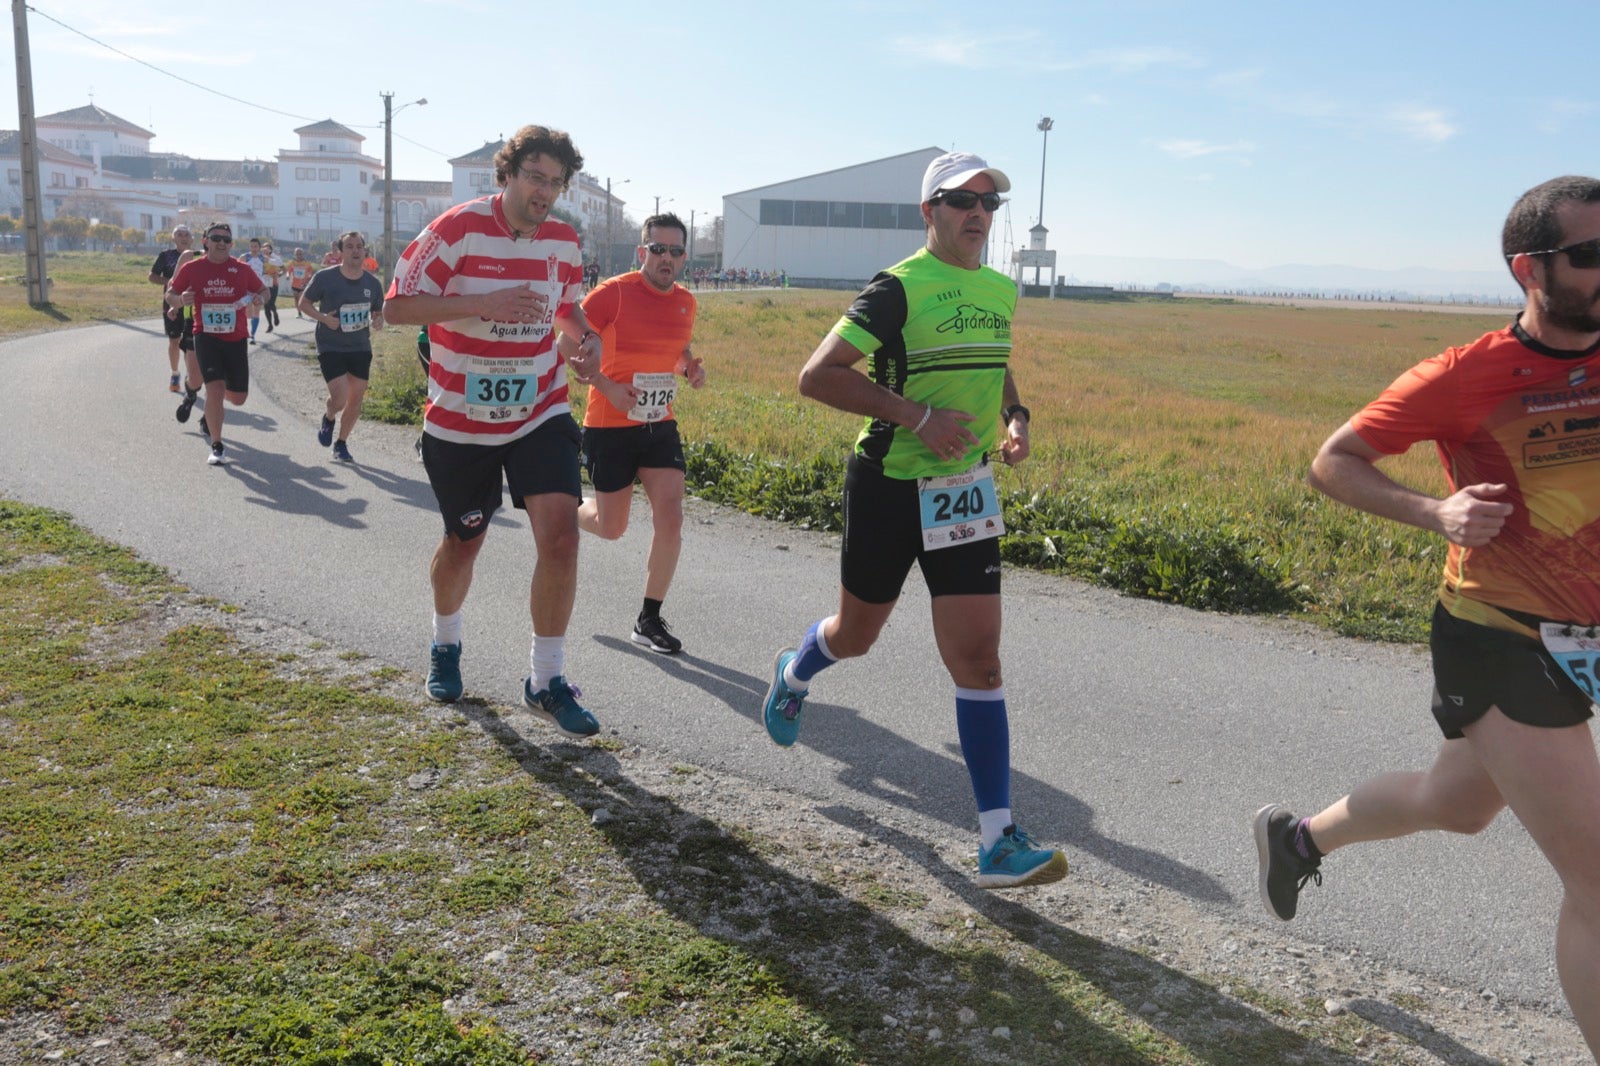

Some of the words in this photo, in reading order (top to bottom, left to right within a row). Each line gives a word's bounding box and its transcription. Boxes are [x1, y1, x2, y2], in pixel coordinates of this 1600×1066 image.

[207, 278, 227, 287] edp
[208, 313, 231, 324] 135
[490, 324, 518, 338] Agua
[478, 378, 527, 402] 367
[638, 389, 673, 406] 3126
[933, 486, 984, 522] 240
